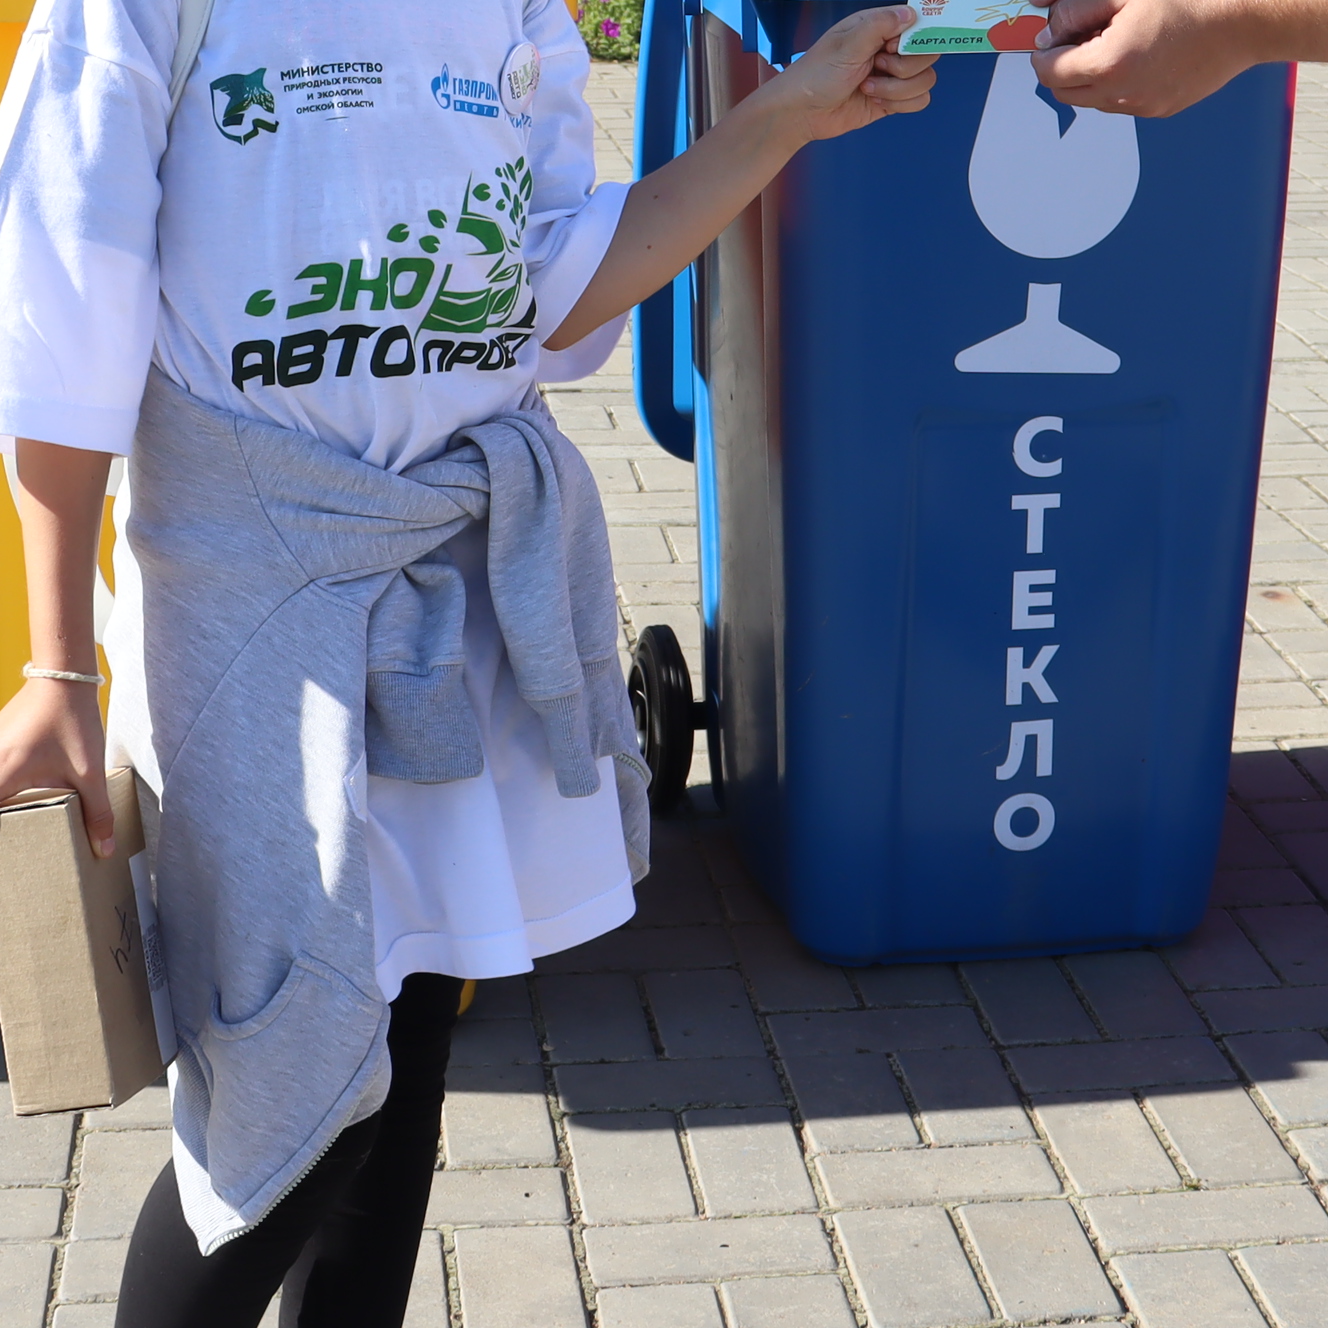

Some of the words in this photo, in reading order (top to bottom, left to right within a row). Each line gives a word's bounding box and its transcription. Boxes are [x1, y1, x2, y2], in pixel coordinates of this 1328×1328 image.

[911, 37, 947, 45] КАРТА
[948, 36, 984, 45] ГОСТЯ
[280, 62, 383, 81] МИНИСТЕРСТВО
[283, 77, 341, 92] ПРИРОДНЫХ
[342, 76, 383, 85] РЕСУРСОВ
[307, 93, 314, 101] И
[317, 88, 364, 99] ЭКОЛОГИИ
[296, 101, 335, 115] ОМСКОЙ
[336, 100, 374, 109] ОБЛАСТИ
[455, 101, 498, 117] НЕФТЬ
[993, 415, 1063, 852] СТЕКЛО
